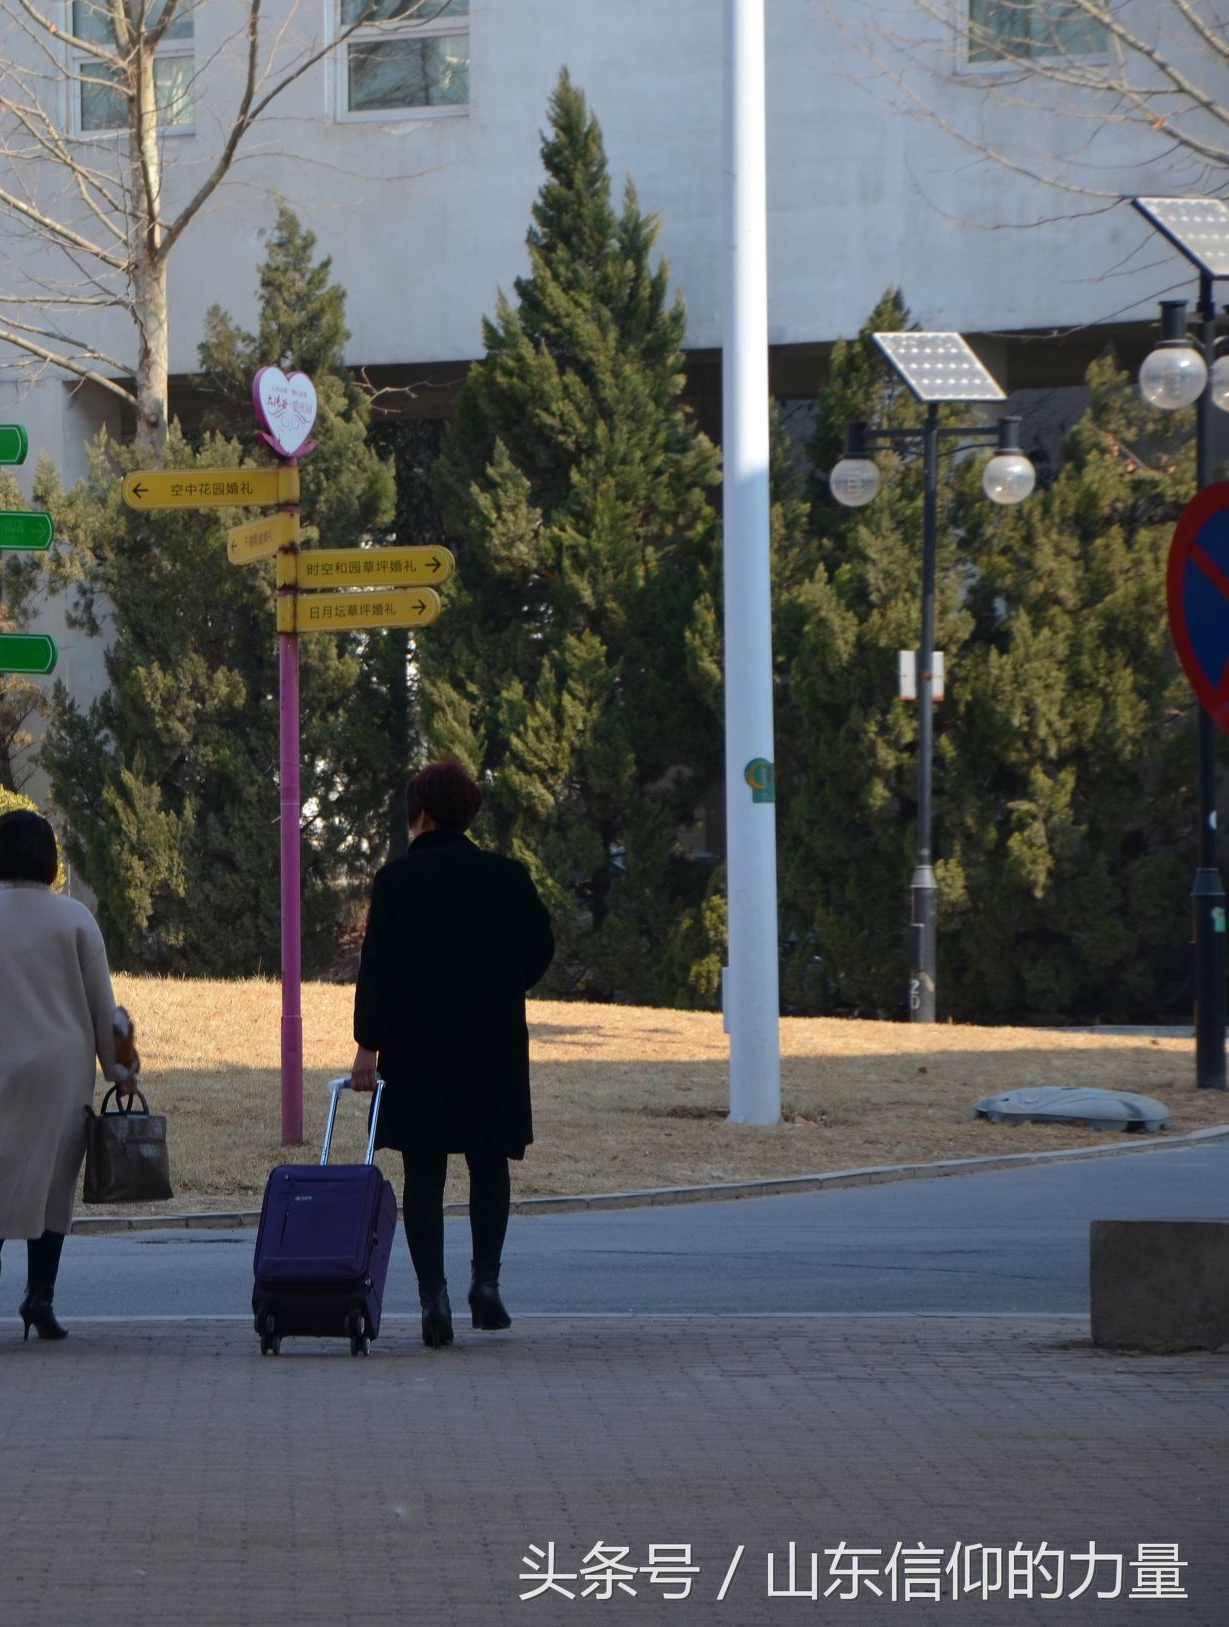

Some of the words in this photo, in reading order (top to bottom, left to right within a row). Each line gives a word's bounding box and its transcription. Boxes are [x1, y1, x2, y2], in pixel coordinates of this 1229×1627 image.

[171, 481, 254, 497] 空中花园婚礼
[307, 559, 417, 577] 时空和园草坪婚礼
[309, 602, 397, 620] 日月坛草坪婚礼
